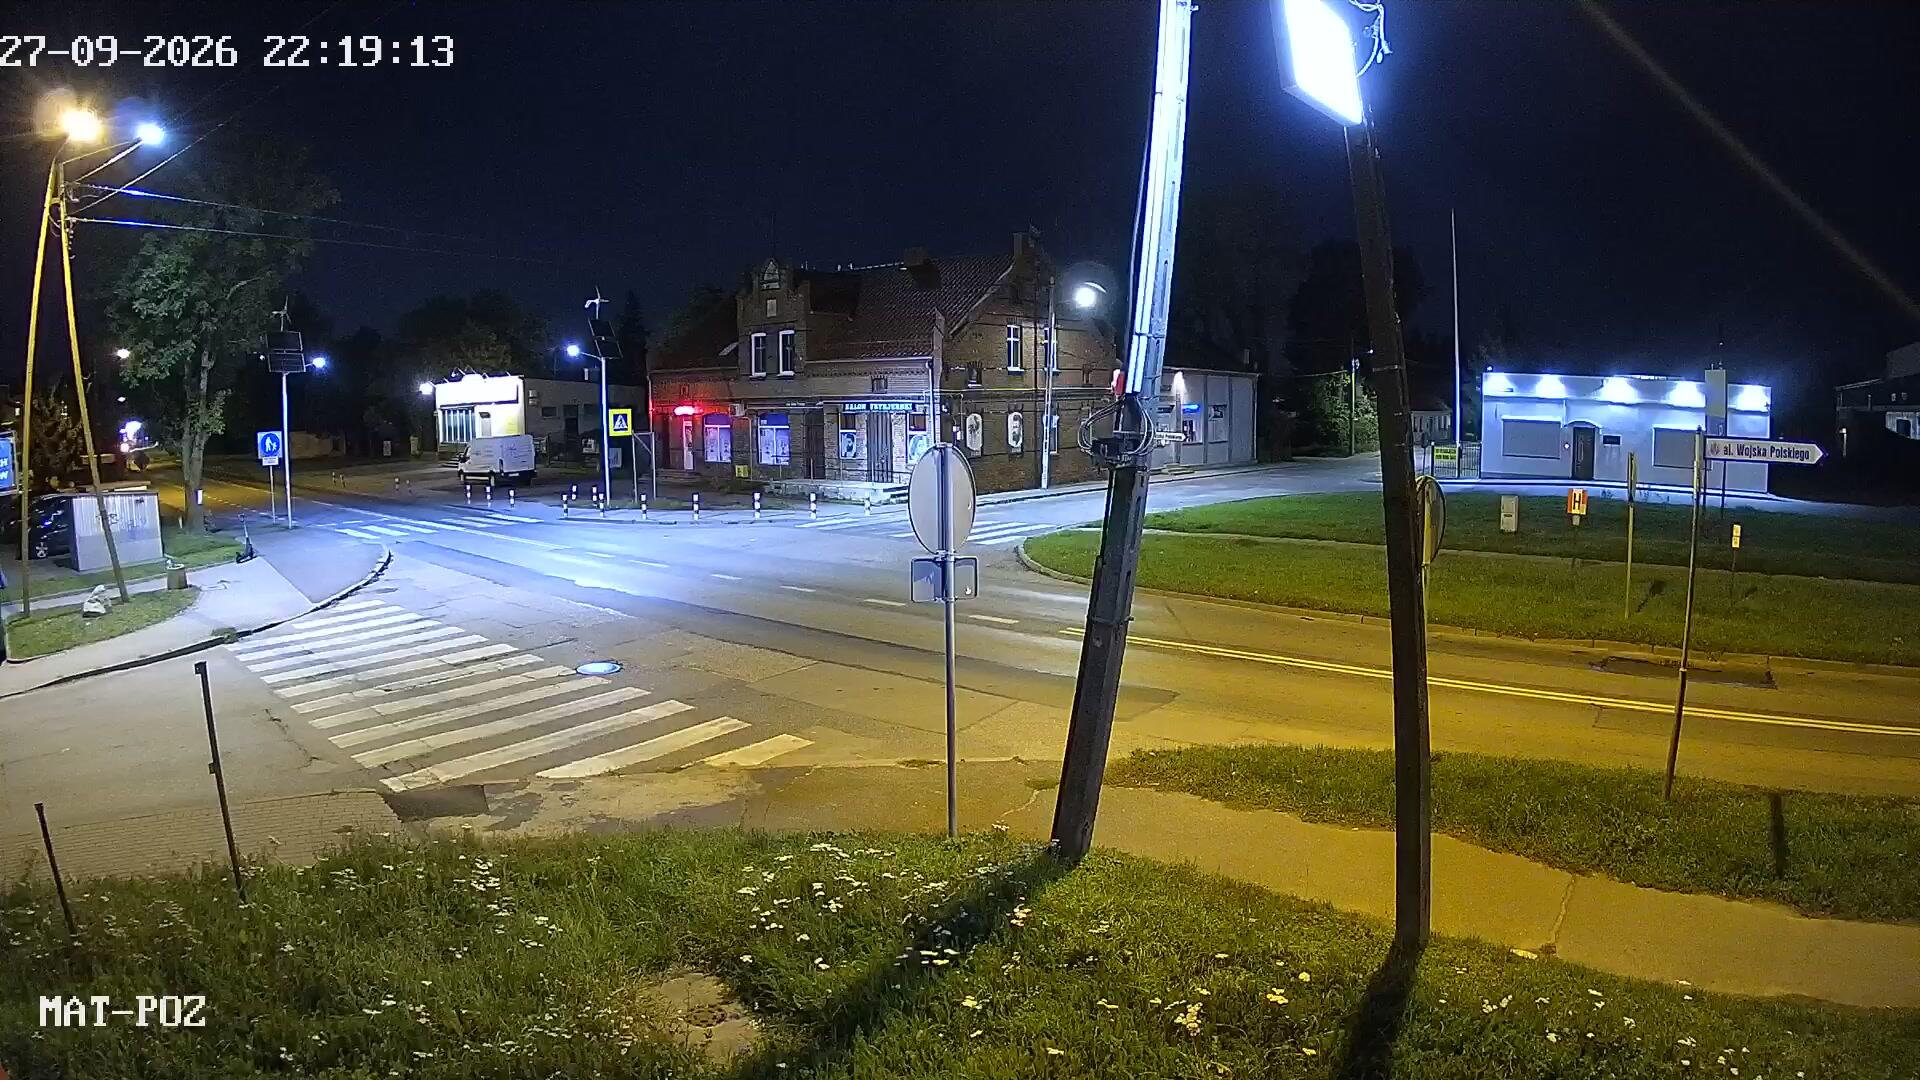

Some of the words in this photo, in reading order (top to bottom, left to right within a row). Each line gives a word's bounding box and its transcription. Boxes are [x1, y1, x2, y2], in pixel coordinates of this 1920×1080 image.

[1723, 443, 1734, 456] al.
[1736, 443, 1767, 459] Wojska
[1770, 446, 1809, 461] Polskiego
